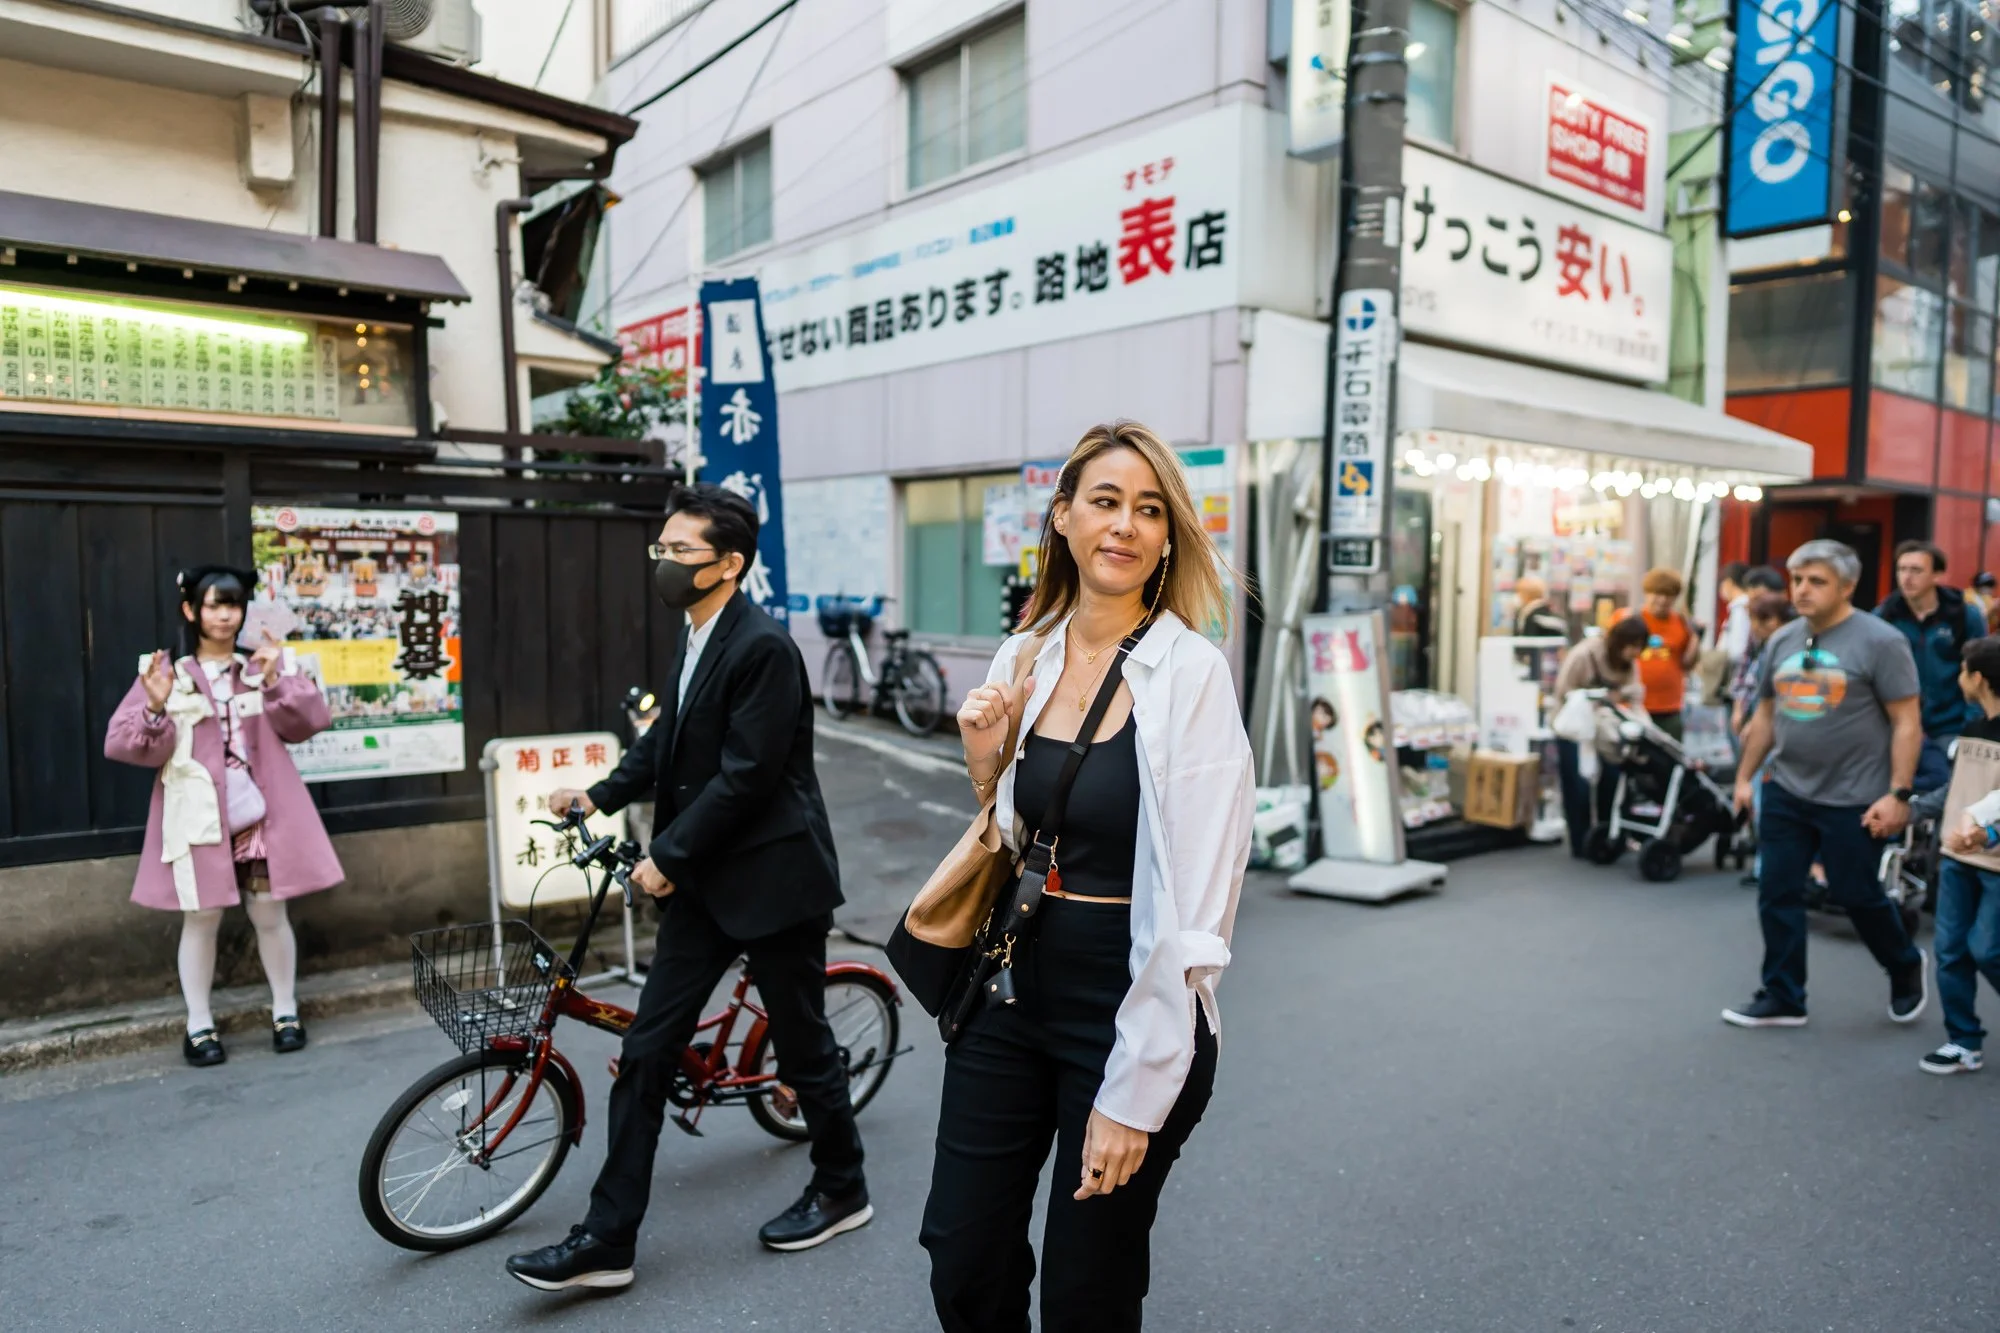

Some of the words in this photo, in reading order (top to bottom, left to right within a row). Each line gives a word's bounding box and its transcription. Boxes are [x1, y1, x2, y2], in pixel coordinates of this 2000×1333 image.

[1751, 0, 1819, 184] GiGO
[1122, 155, 1175, 191] オモテ
[515, 742, 607, 773] 菊正宗
